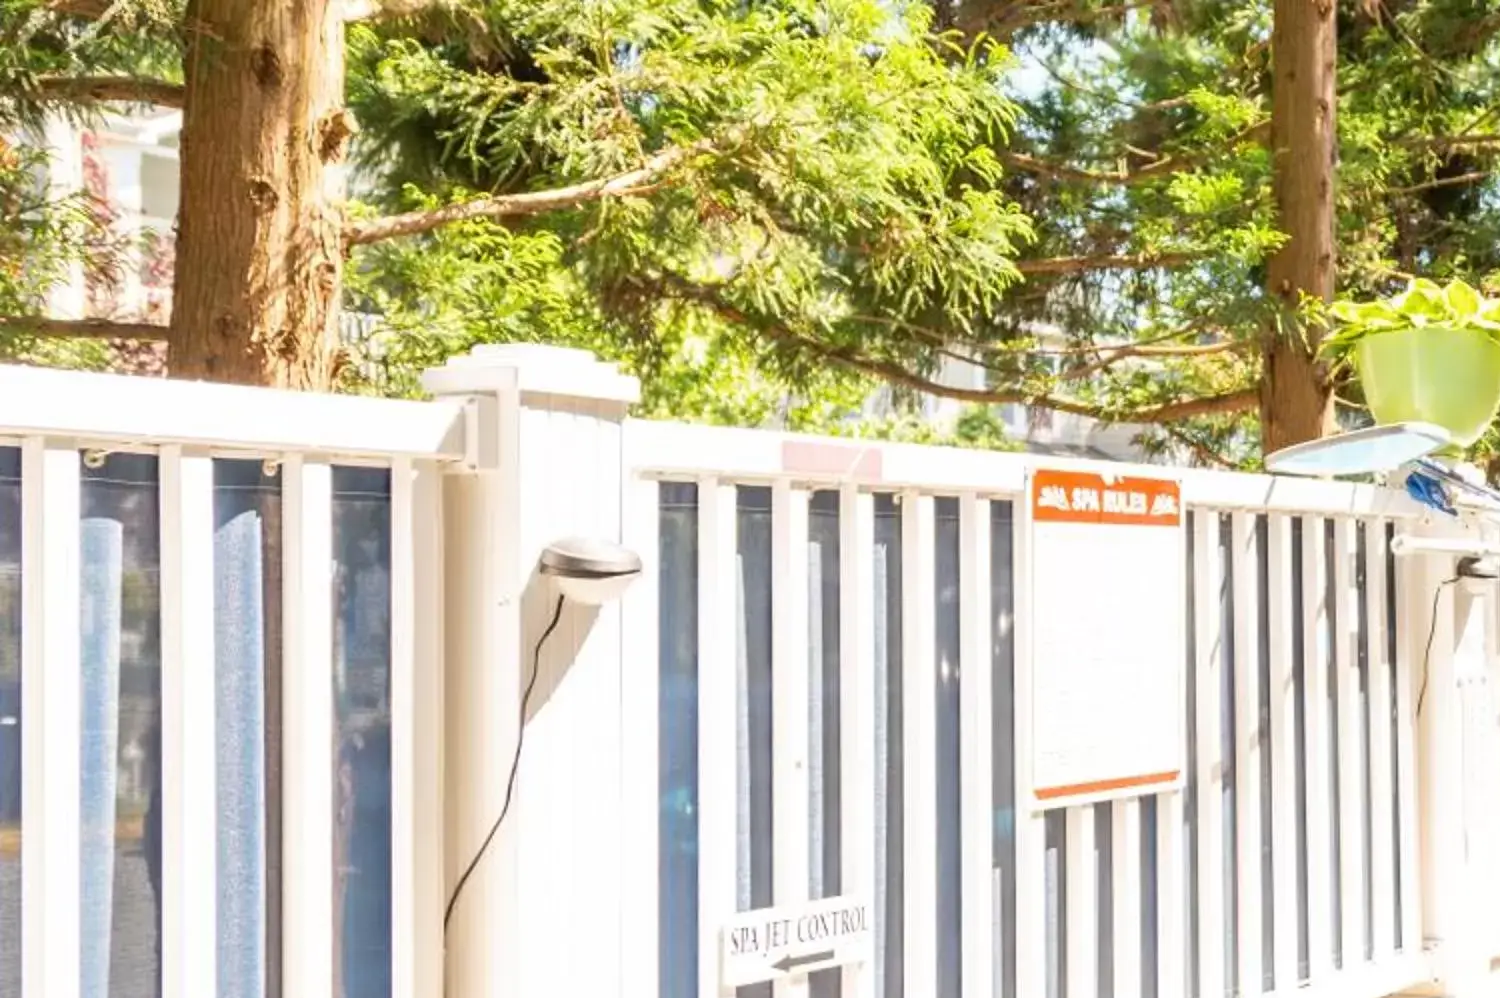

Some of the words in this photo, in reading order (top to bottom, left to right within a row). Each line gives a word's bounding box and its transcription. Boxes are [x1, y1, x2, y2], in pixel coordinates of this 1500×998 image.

[731, 927, 759, 956] SPA
[763, 920, 791, 956] JET
[797, 906, 868, 943] CONTROL
